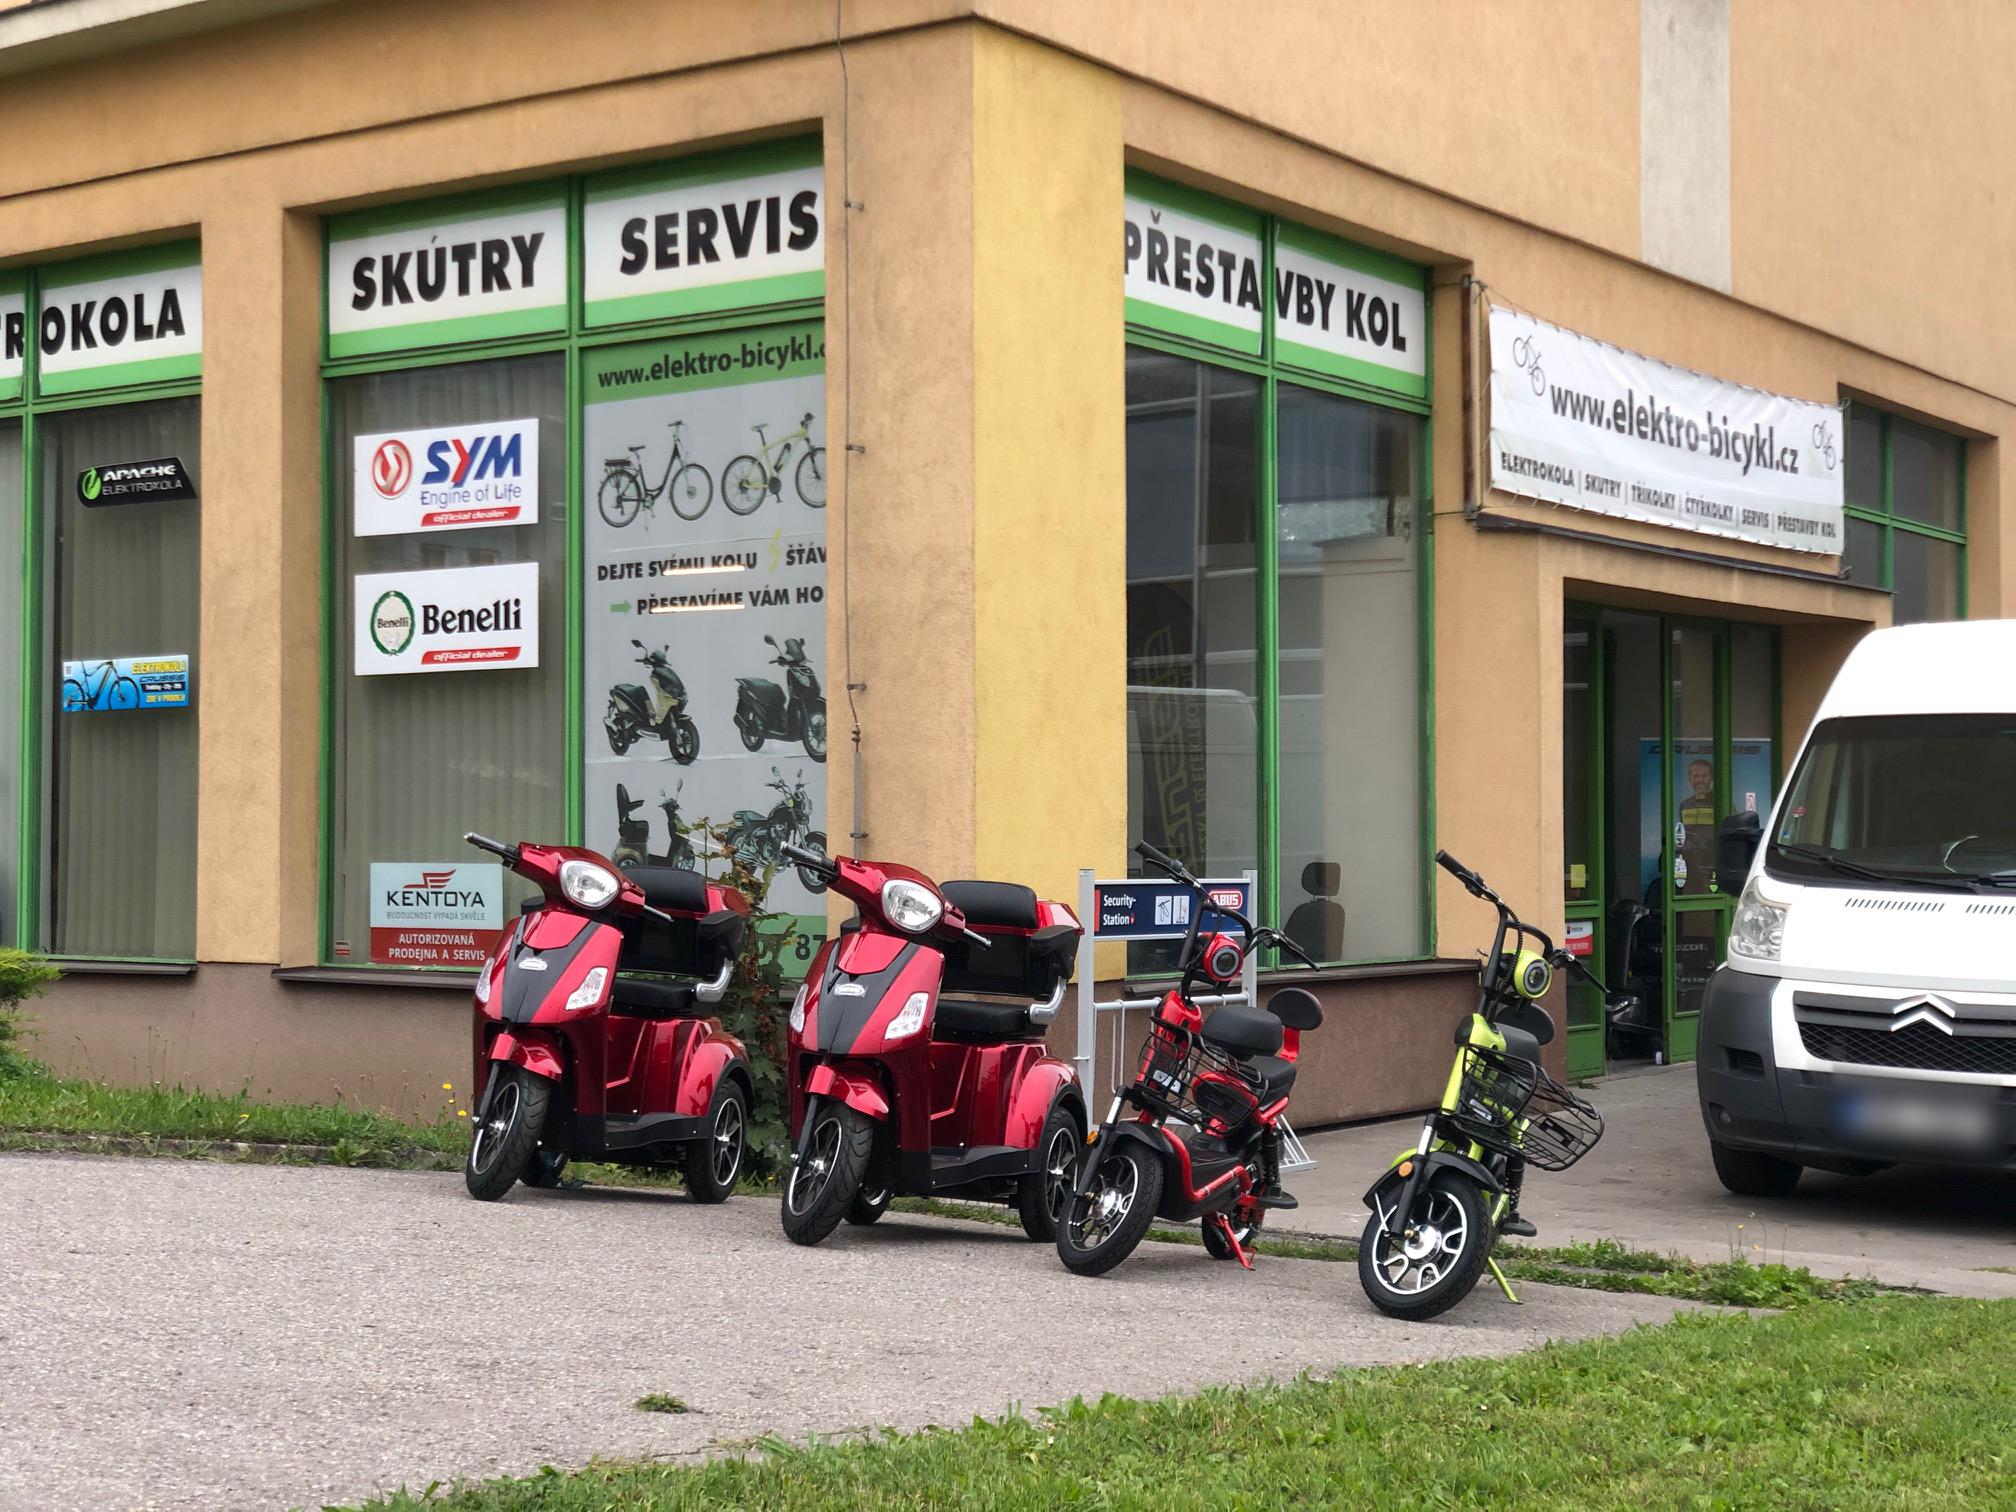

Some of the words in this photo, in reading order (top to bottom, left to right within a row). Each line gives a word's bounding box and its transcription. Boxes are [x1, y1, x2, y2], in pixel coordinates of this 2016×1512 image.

[620, 191, 818, 275] SERVIS
[352, 232, 545, 311] SKÚTRY
[1346, 288, 1406, 352] KOL
[1550, 385, 1798, 476] www.elektro-bicykl.cz
[421, 433, 521, 488] SYM
[103, 465, 177, 481] APACHE
[102, 480, 183, 495] ELEKTROKOLA
[1501, 452, 1575, 487] ELEKTROKOLA
[1742, 508, 1770, 528] SERVIS
[421, 489, 470, 509] Engine
[475, 484, 489, 501] of
[494, 483, 522, 502] Life
[433, 511, 471, 523] official
[472, 508, 509, 520] dealer
[597, 562, 643, 581] DEJTE
[711, 552, 757, 571] KOLU
[749, 584, 789, 606] VÁM
[796, 585, 824, 604] HO
[377, 616, 410, 629] Benelli
[422, 598, 522, 635] Benelli
[433, 652, 471, 663] official
[472, 649, 508, 660] dealer
[387, 891, 485, 907] KENTOYA
[1103, 894, 1136, 909] Security-
[1213, 894, 1239, 906] ABUS
[387, 911, 432, 920] BUDOUCNOST
[434, 910, 459, 920] VYPADÁ
[460, 910, 485, 920] SKVĚLE
[1103, 914, 1130, 926] Station
[399, 932, 474, 946] AUTORIZOVANÁ
[389, 948, 438, 961] PRODEJNA
[442, 950, 449, 960] A
[453, 950, 485, 961] SERVIS
